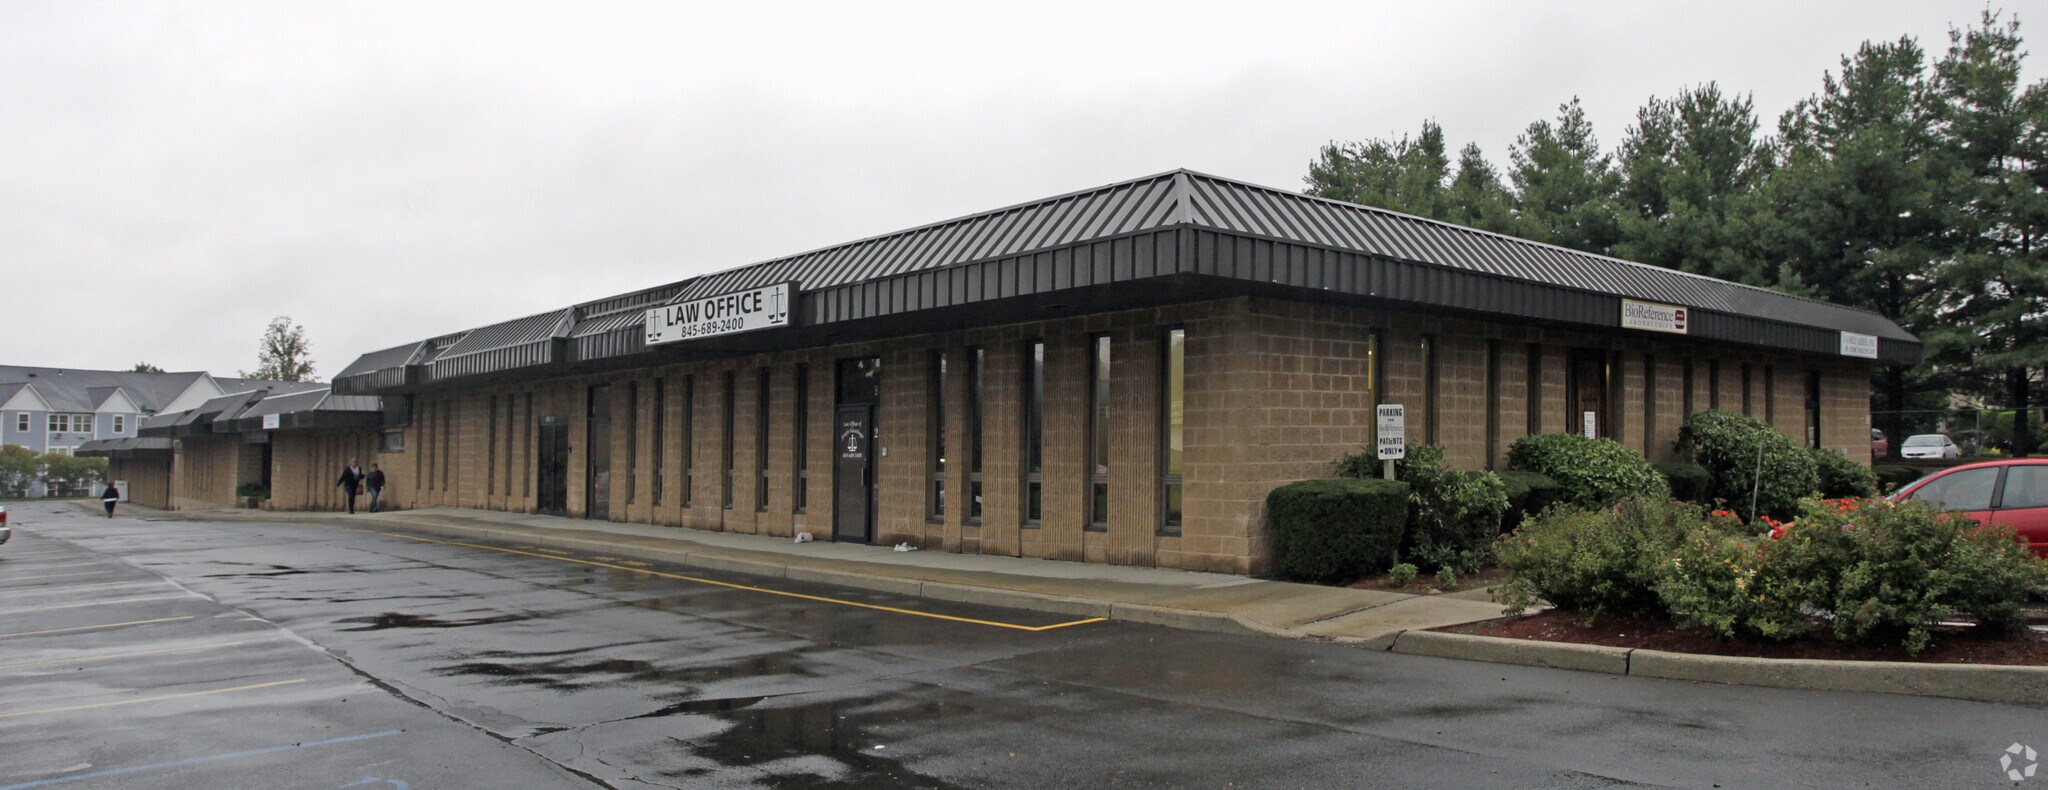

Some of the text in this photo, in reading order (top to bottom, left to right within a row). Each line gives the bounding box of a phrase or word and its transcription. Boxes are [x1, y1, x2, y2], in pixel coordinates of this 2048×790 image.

[666, 290, 762, 327] LAW OFFICE
[1625, 302, 1674, 322] BioReference
[681, 316, 744, 338] 845-689-2400
[1625, 319, 1673, 329] LABORATORIES
[1379, 408, 1403, 417] PARKING
[873, 427, 879, 439] 2
[1379, 437, 1403, 446] PATIENTS
[1384, 447, 1398, 455] ONLY
